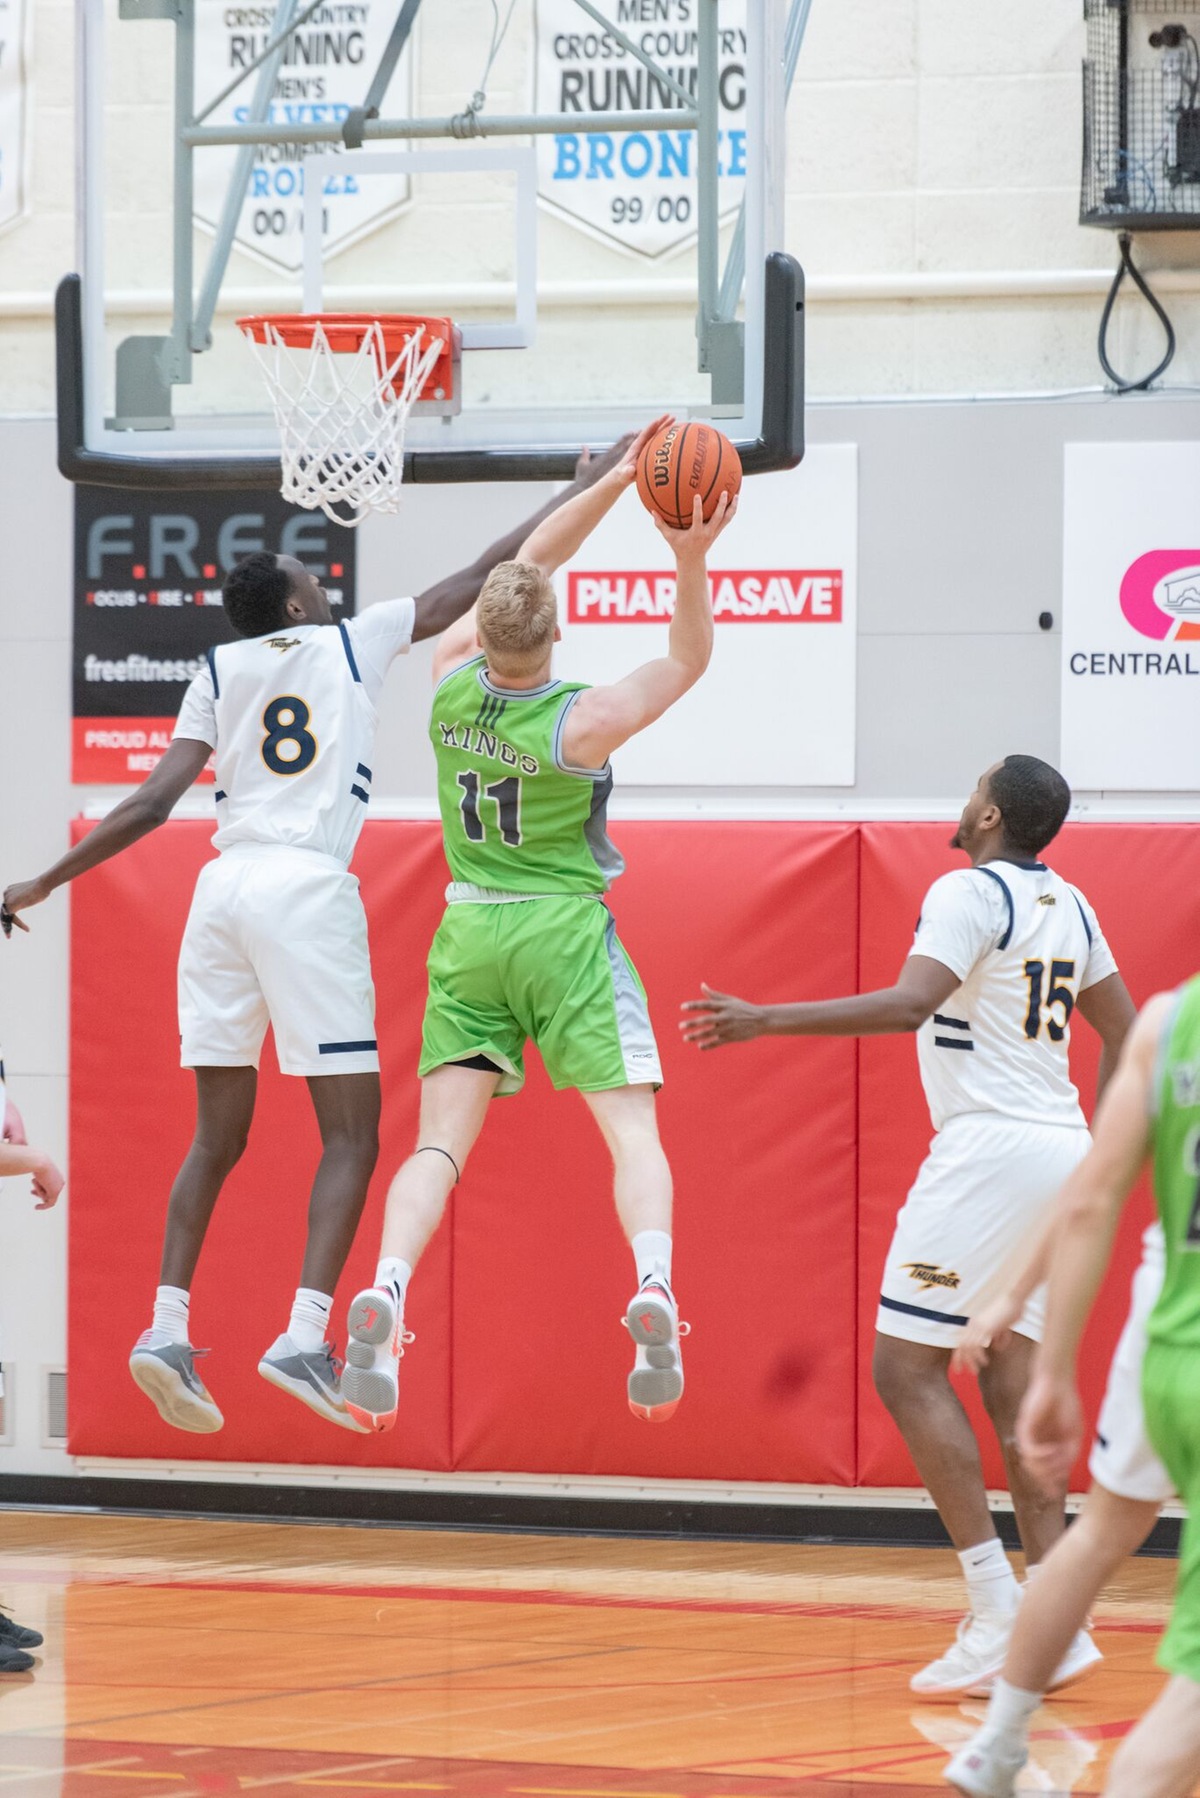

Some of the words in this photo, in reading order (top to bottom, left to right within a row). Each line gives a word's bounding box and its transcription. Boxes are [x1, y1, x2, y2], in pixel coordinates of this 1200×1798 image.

[617, 0, 690, 23] MEN'S
[229, 32, 365, 68] RUNING
[552, 130, 746, 179] BRONE
[252, 167, 358, 197] ROZE
[654, 425, 681, 488] Wilson
[575, 577, 833, 617] PHARASAVE
[1069, 653, 1200, 676] CENTRAL
[261, 694, 320, 778] 8
[438, 720, 540, 776] KINGS
[456, 768, 523, 849] 11
[1023, 958, 1076, 1042] 15
[899, 1261, 962, 1292] THUNDER
